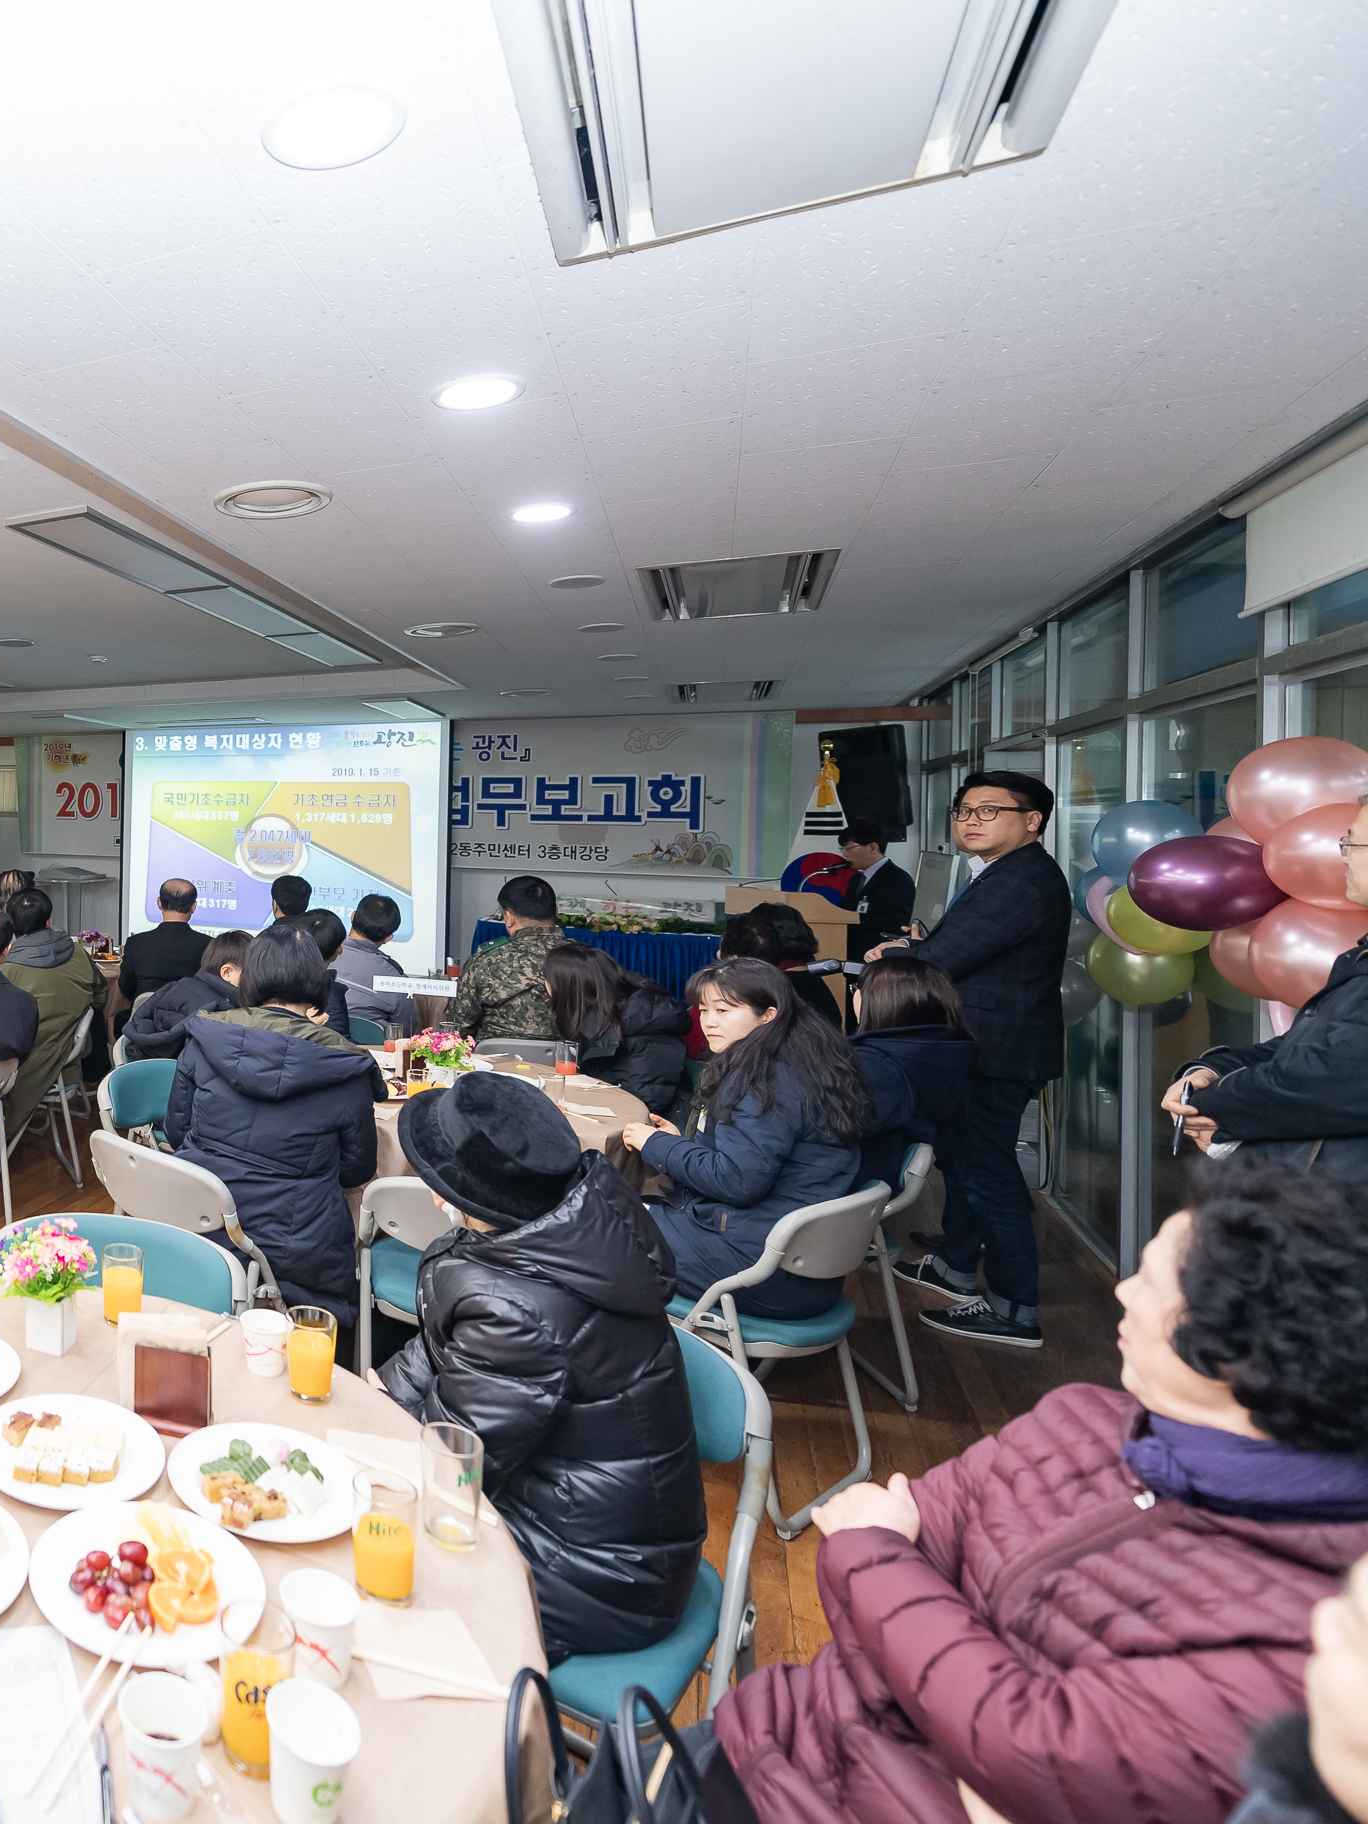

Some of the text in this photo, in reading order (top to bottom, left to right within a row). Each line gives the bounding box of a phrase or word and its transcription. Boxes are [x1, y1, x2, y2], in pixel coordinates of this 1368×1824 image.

[135, 732, 322, 751] 3. 맞춤형 복지대상자 현황
[373, 729, 417, 748] 광진
[44, 742, 72, 752] 2019년
[46, 754, 69, 763] 기해년
[332, 768, 356, 777] 2019.
[369, 768, 379, 777] 15
[383, 768, 401, 777] 기준
[164, 792, 250, 806] 국민기초수급자
[292, 793, 397, 808] 기초연금 수급자
[211, 810, 239, 822] 557명
[295, 812, 394, 825] 1,317세대 1,628명
[537, 844, 610, 862] 3층대강당
[208, 898, 237, 910] 317명
[369, 1521, 402, 1536] Hite
[235, 1680, 271, 1705] Cas
